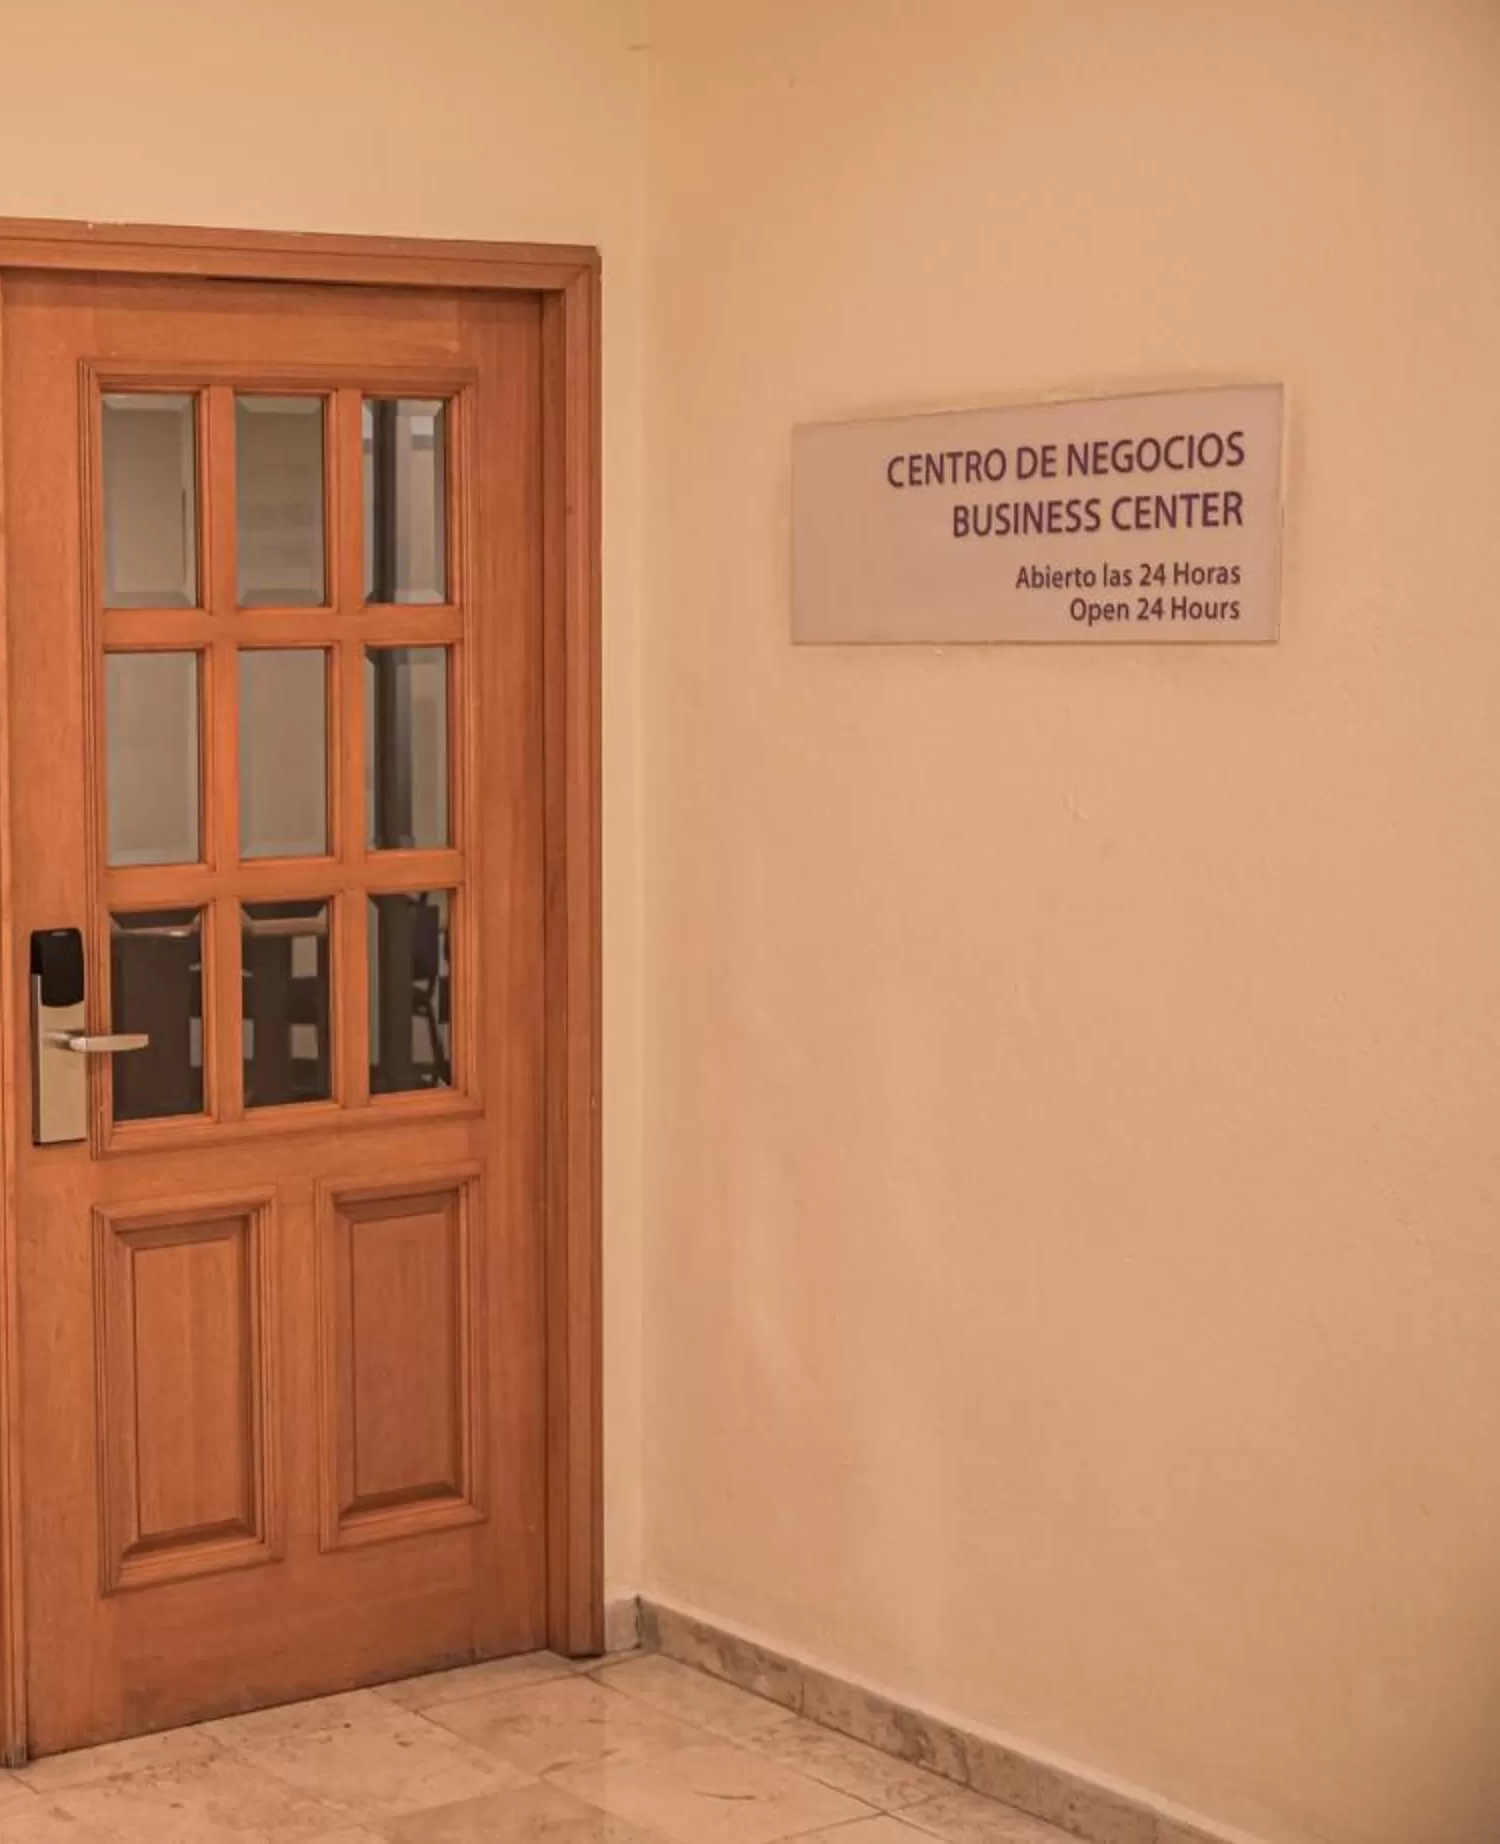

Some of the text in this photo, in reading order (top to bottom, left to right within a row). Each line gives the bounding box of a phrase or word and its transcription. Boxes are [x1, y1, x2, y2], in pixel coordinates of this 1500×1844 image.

[887, 431, 1245, 488] CENTRO DE NEGOCIOS
[953, 491, 1244, 537] BUSINESS CENTER
[1015, 562, 1241, 590] Abierto las 24 Horas
[1070, 596, 1241, 626] Open 24 Hours
